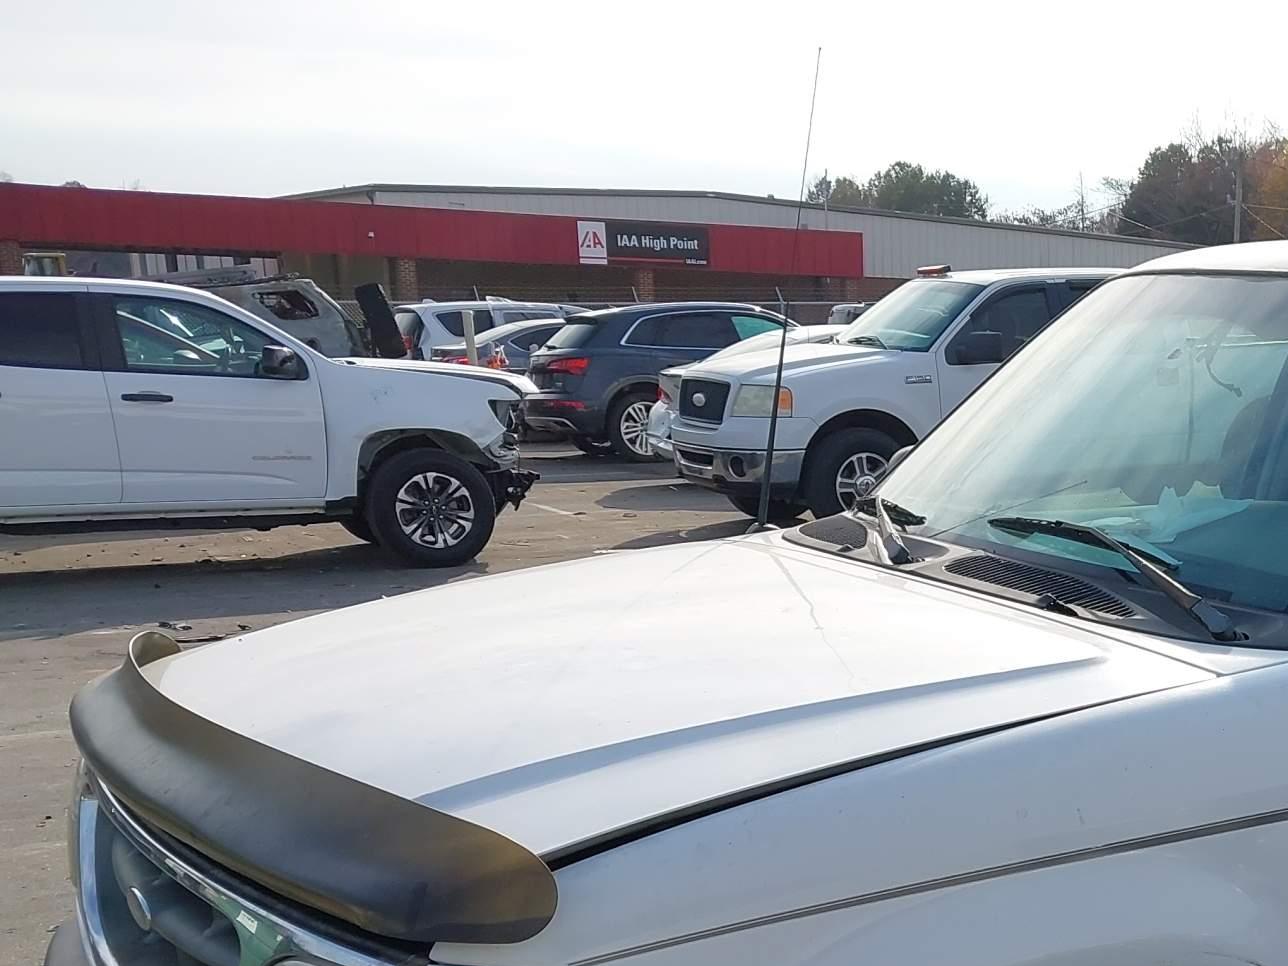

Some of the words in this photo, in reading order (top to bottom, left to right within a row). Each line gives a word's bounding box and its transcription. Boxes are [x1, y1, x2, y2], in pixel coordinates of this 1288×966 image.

[616, 234, 639, 248] IAA
[641, 235, 667, 251] High
[669, 236, 699, 250] Point
